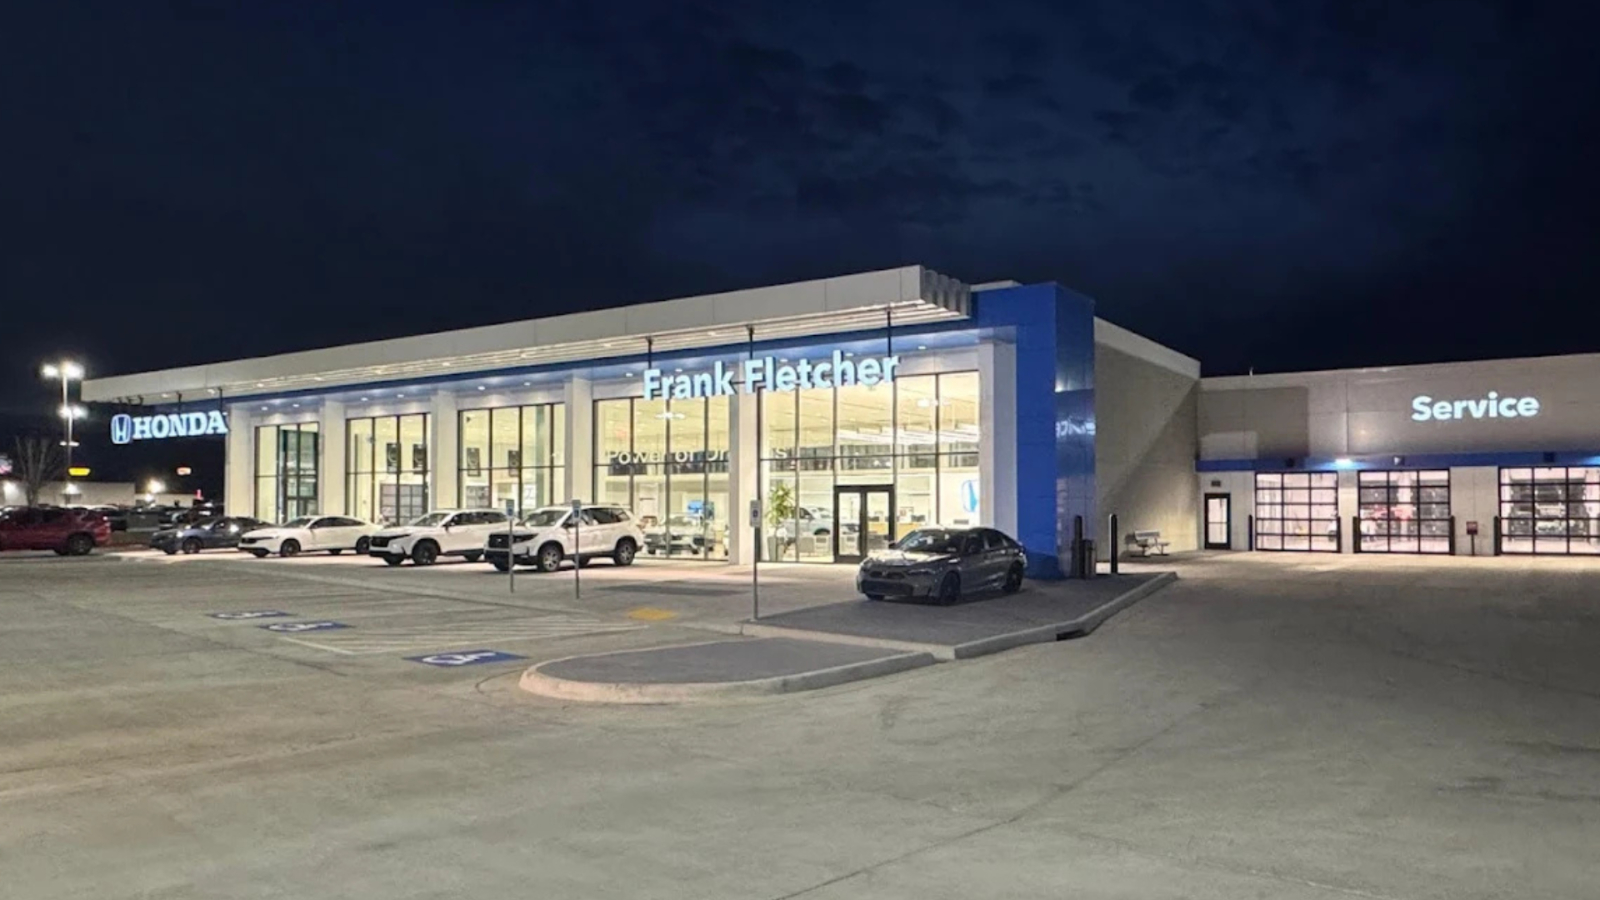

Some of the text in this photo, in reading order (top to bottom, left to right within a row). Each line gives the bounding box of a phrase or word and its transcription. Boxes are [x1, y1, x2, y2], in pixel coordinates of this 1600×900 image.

[643, 349, 899, 400] Frank Fletcher
[1411, 391, 1540, 421] Service
[133, 410, 228, 440] HONDA
[606, 450, 667, 465] Power
